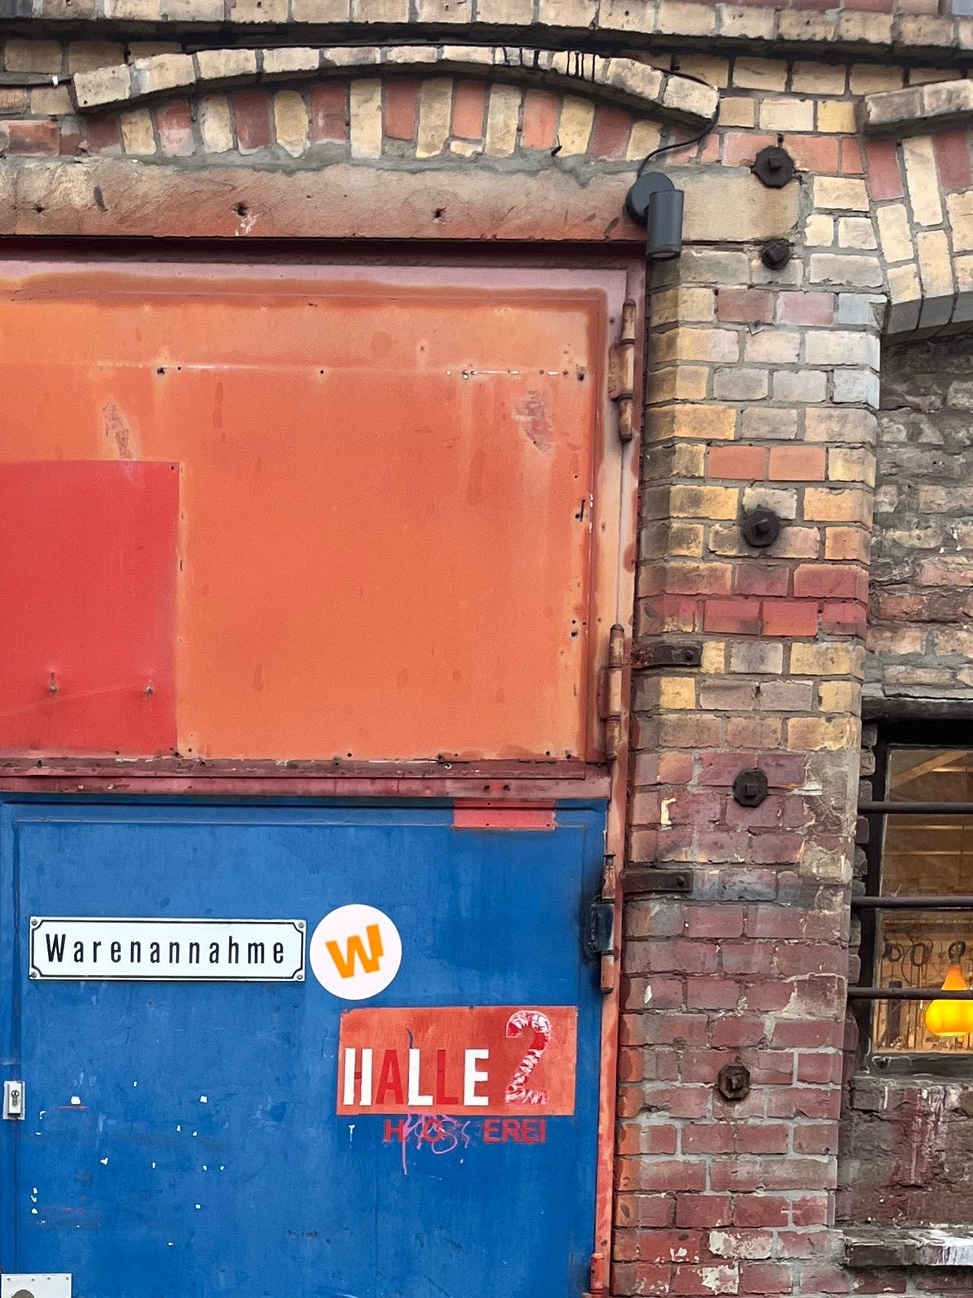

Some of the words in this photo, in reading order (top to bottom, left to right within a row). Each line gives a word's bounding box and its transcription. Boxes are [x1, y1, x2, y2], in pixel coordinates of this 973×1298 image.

[45, 933, 286, 965] Warenannahme
[342, 1047, 490, 1106] HALLE
[505, 1010, 552, 1106] 2
